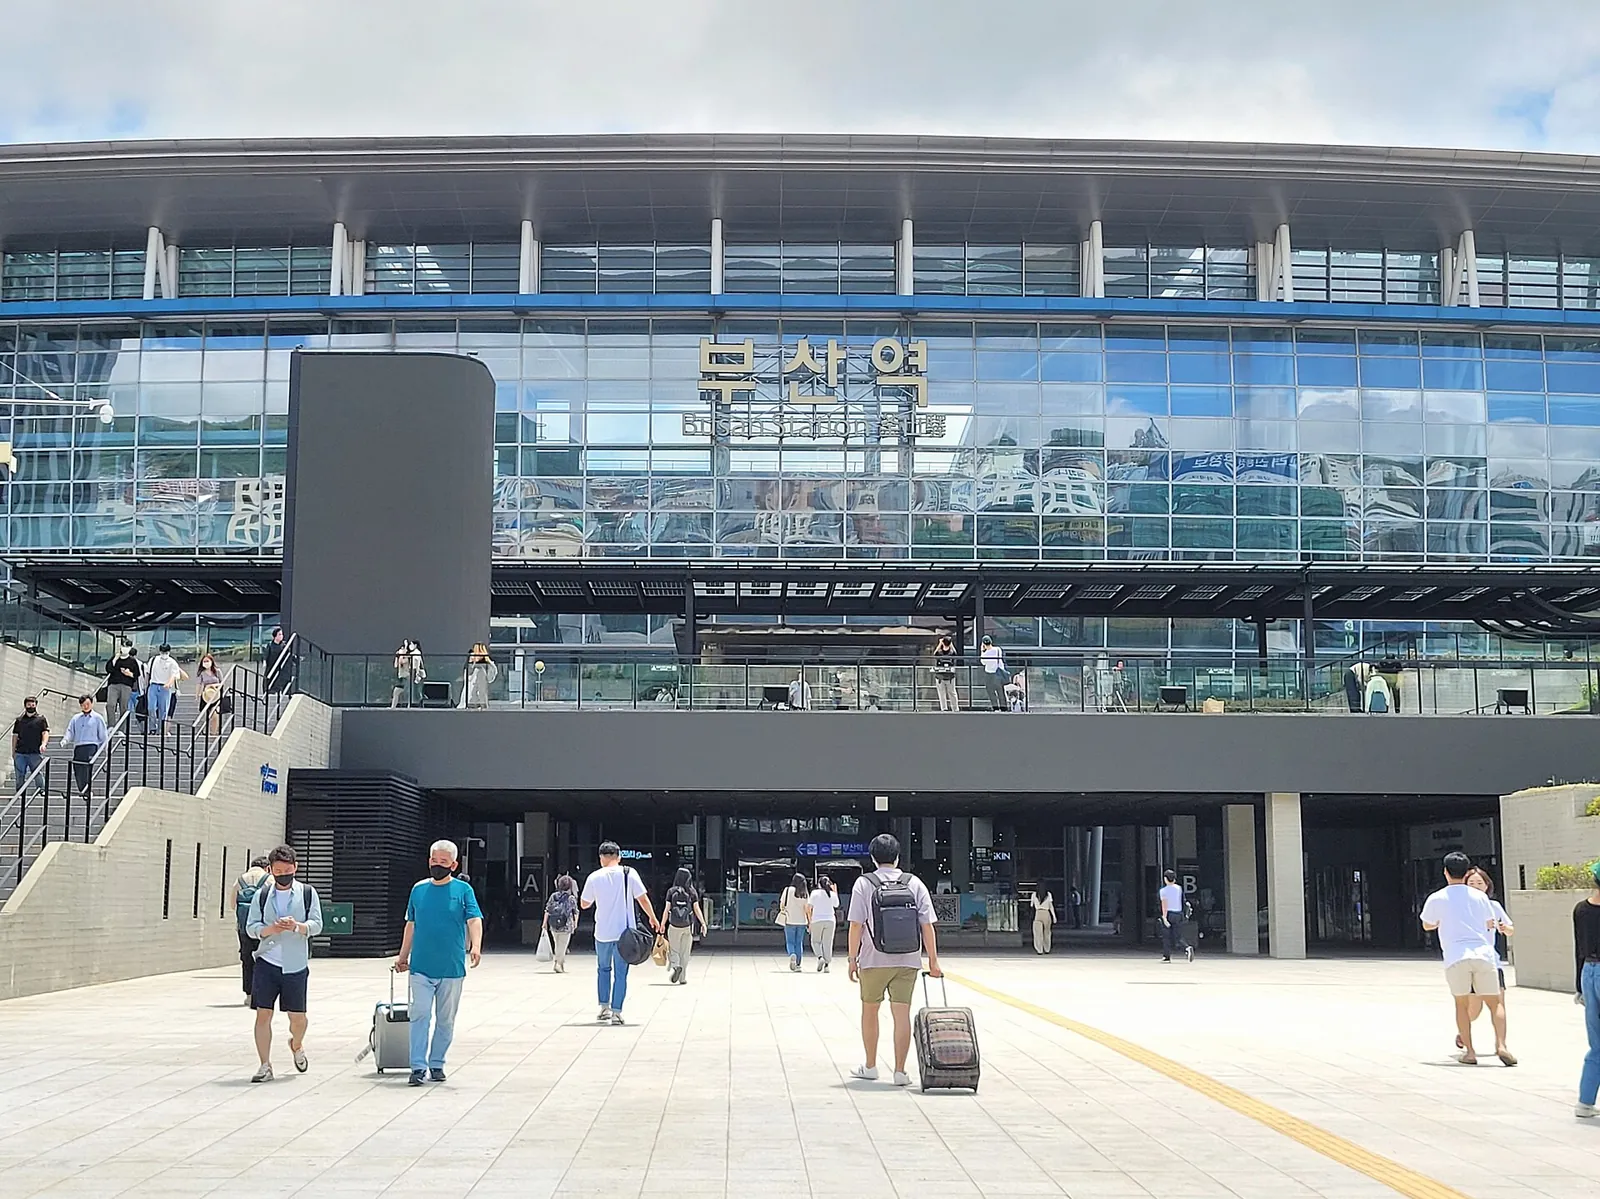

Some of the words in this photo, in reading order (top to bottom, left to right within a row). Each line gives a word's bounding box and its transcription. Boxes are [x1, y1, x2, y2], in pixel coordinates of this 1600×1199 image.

[697, 337, 928, 408] 부산역
[682, 412, 764, 437] Busan
[772, 413, 871, 437] Station
[523, 873, 539, 892] A
[1183, 875, 1198, 894] B
